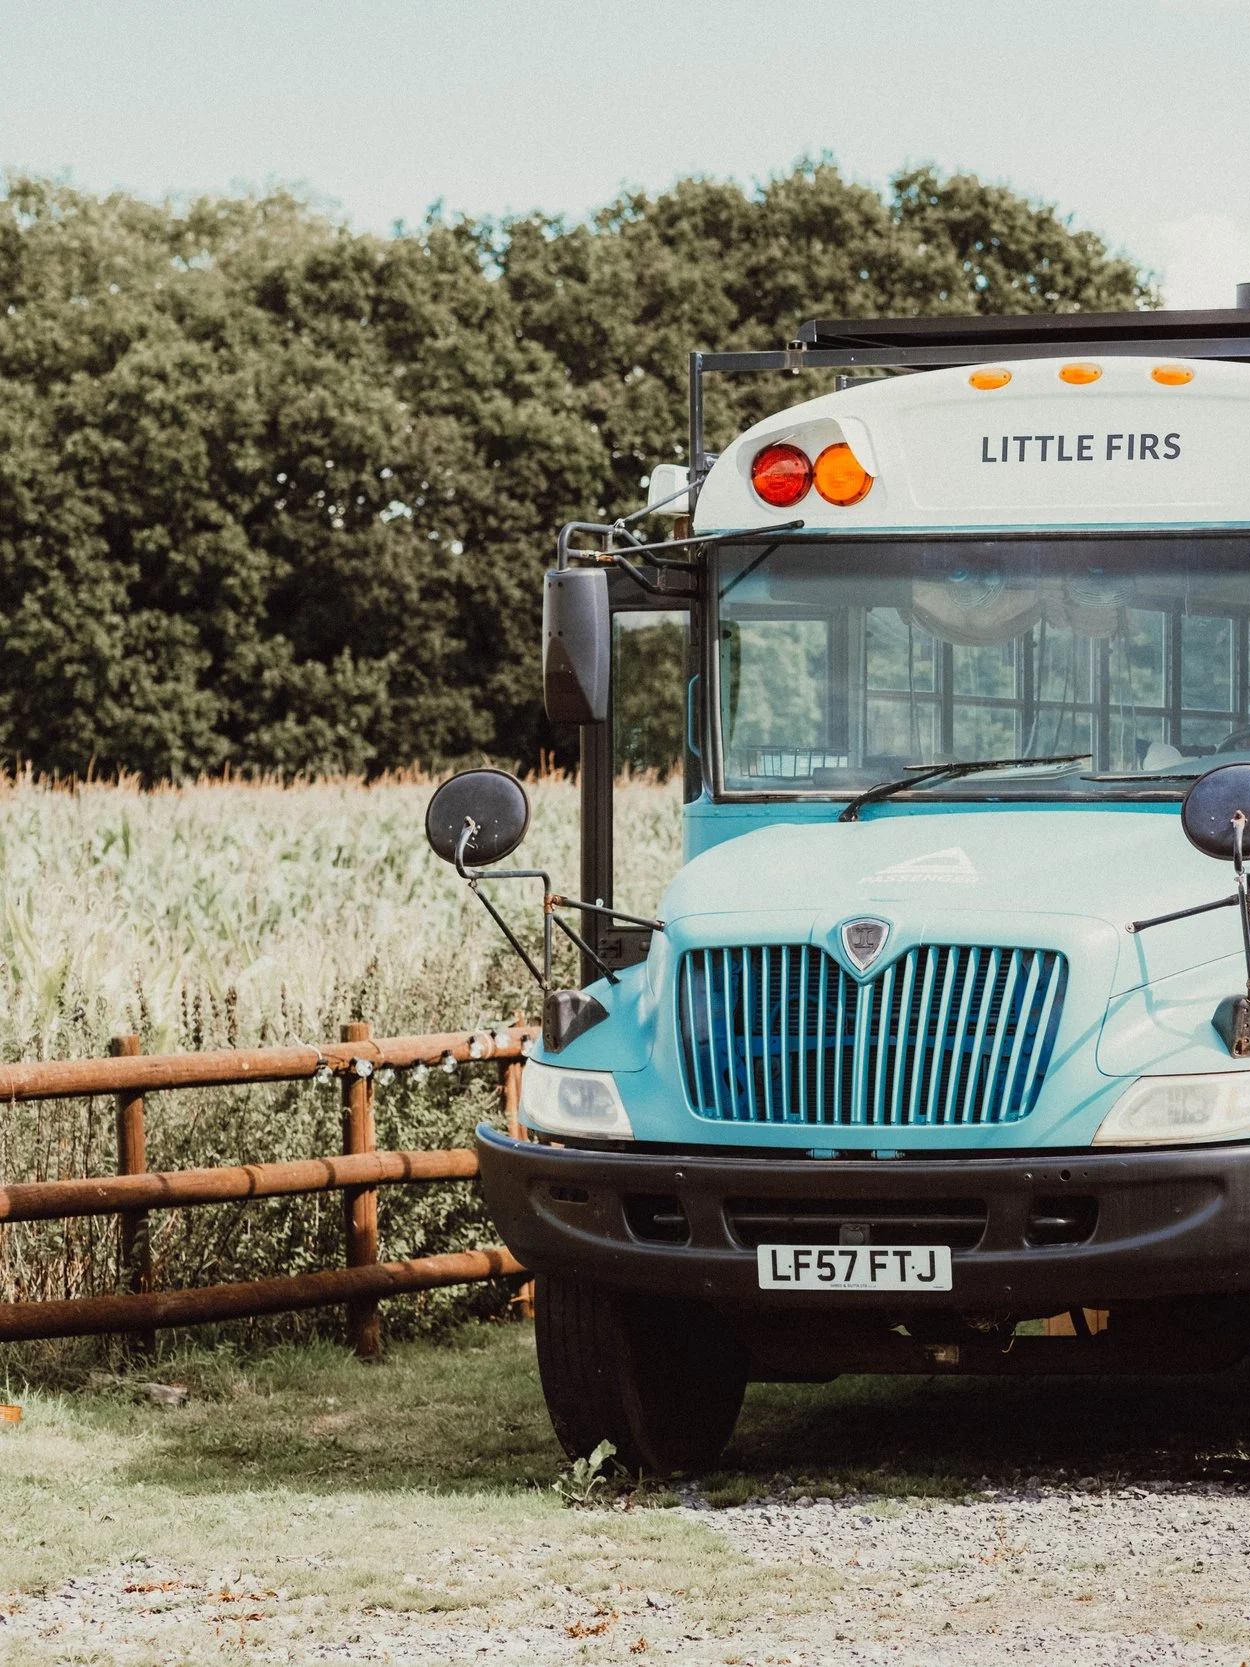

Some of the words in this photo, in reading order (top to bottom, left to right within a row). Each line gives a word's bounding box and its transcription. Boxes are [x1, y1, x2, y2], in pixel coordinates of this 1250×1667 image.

[981, 434, 1095, 463] LITTLE
[1105, 432, 1182, 461] FIRS
[771, 1249, 858, 1282] LF57
[869, 1249, 936, 1283] FTJ
